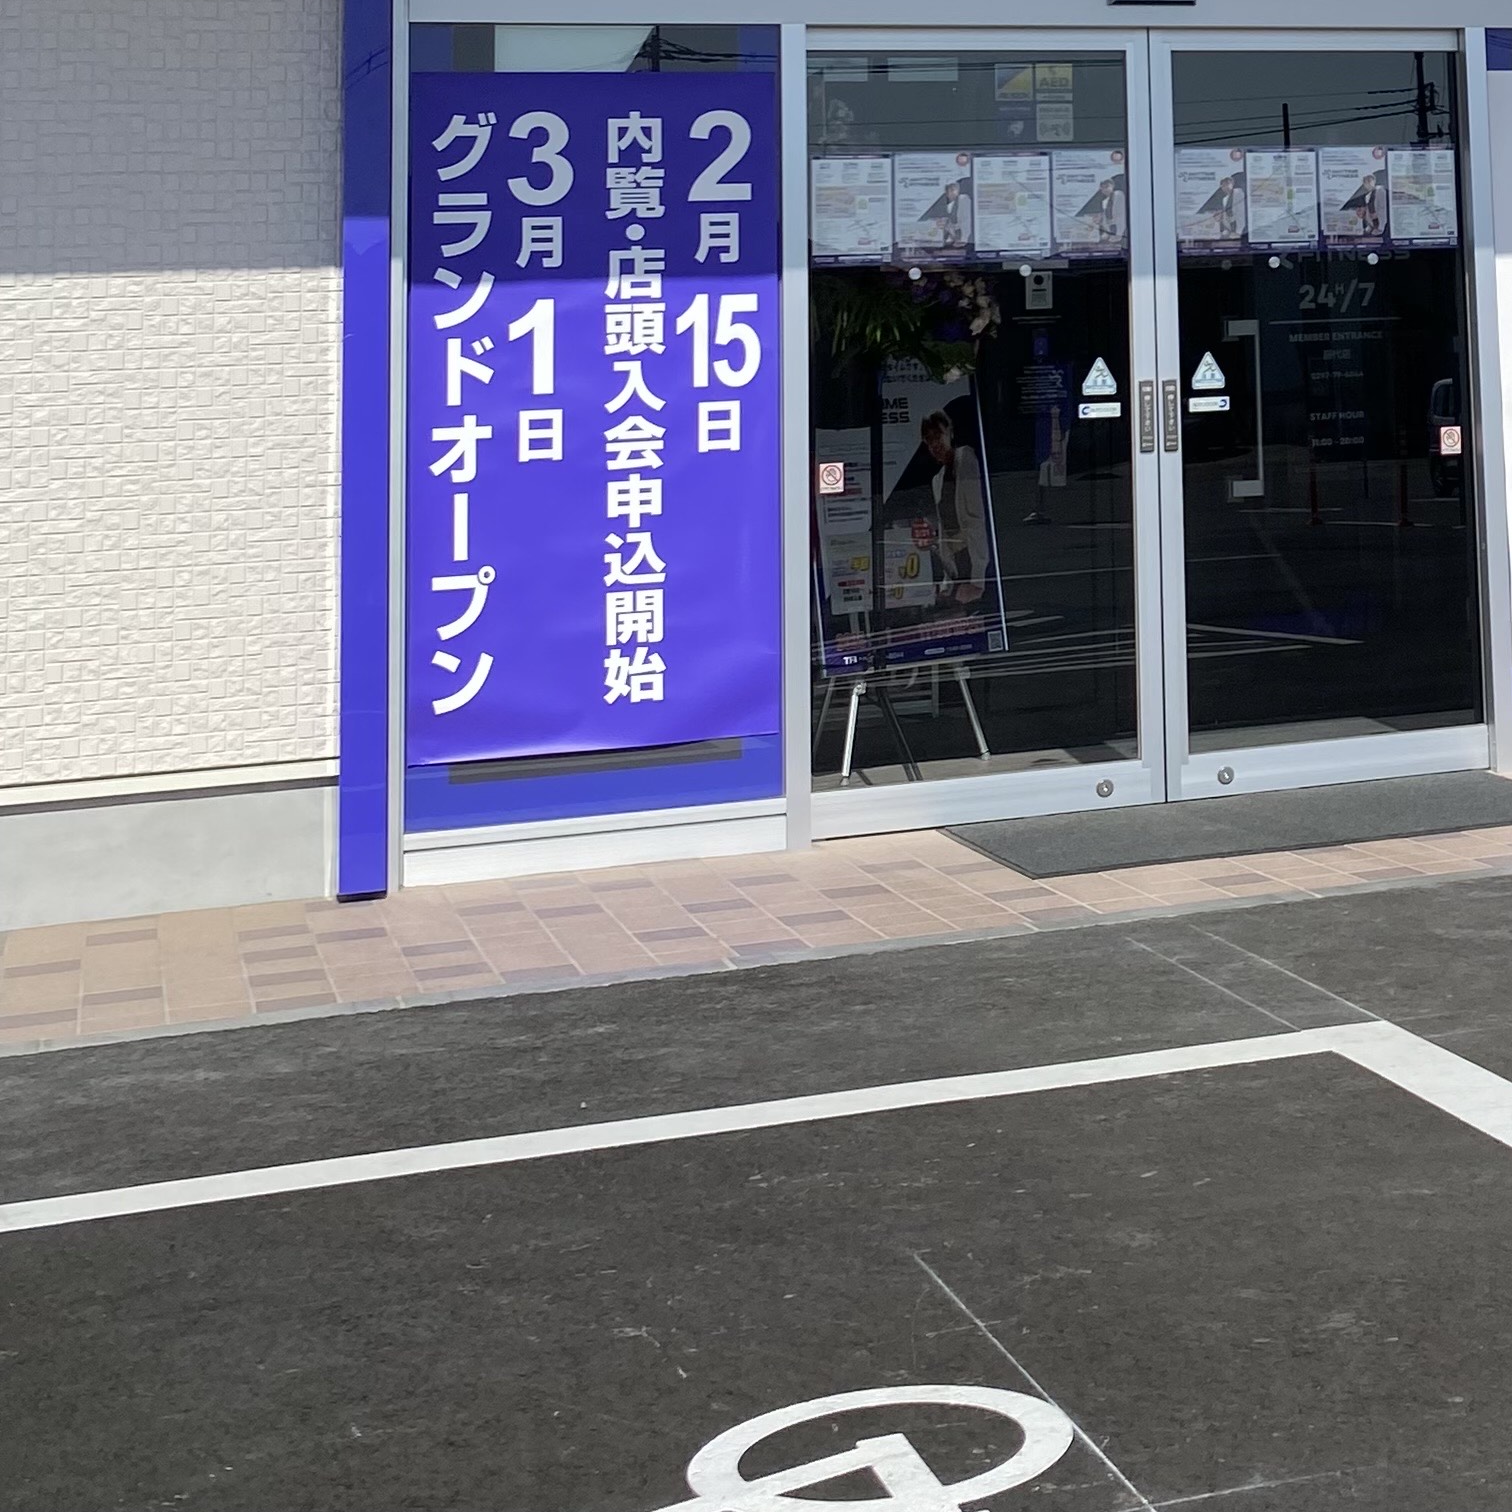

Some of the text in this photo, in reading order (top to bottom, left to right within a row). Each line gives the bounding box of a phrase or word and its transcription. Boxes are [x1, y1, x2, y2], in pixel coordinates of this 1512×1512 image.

[430, 111, 497, 716] グランドオープン
[603, 111, 667, 705] 内覧・店頭入会申込開始
[1309, 411, 1338, 421] STAFF
